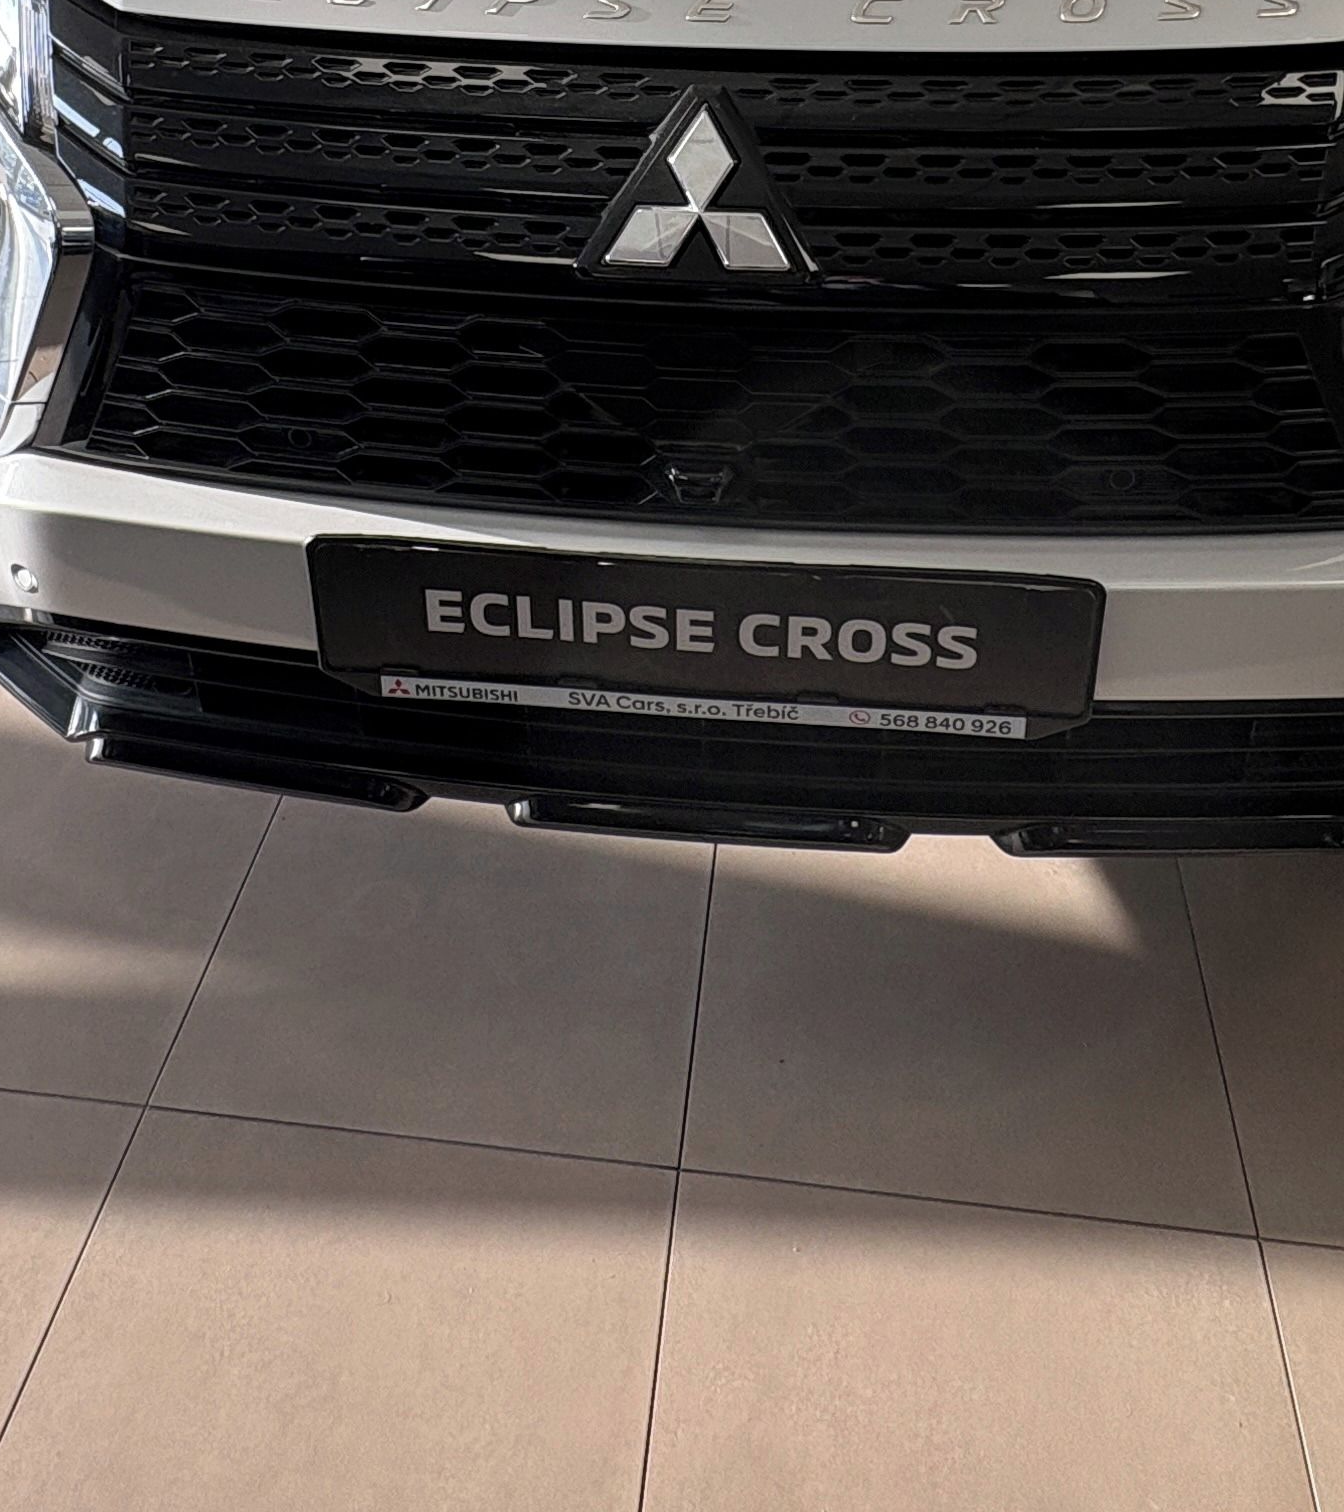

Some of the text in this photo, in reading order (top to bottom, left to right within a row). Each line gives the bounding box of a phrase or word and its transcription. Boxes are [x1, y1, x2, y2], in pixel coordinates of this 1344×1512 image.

[425, 589, 978, 669] ECLIPSE CROSS
[414, 682, 519, 703] MITSUBISHI
[567, 691, 800, 722] SVA Cars, s.r.o. Třebíč
[879, 712, 1012, 735] 568 840 926
